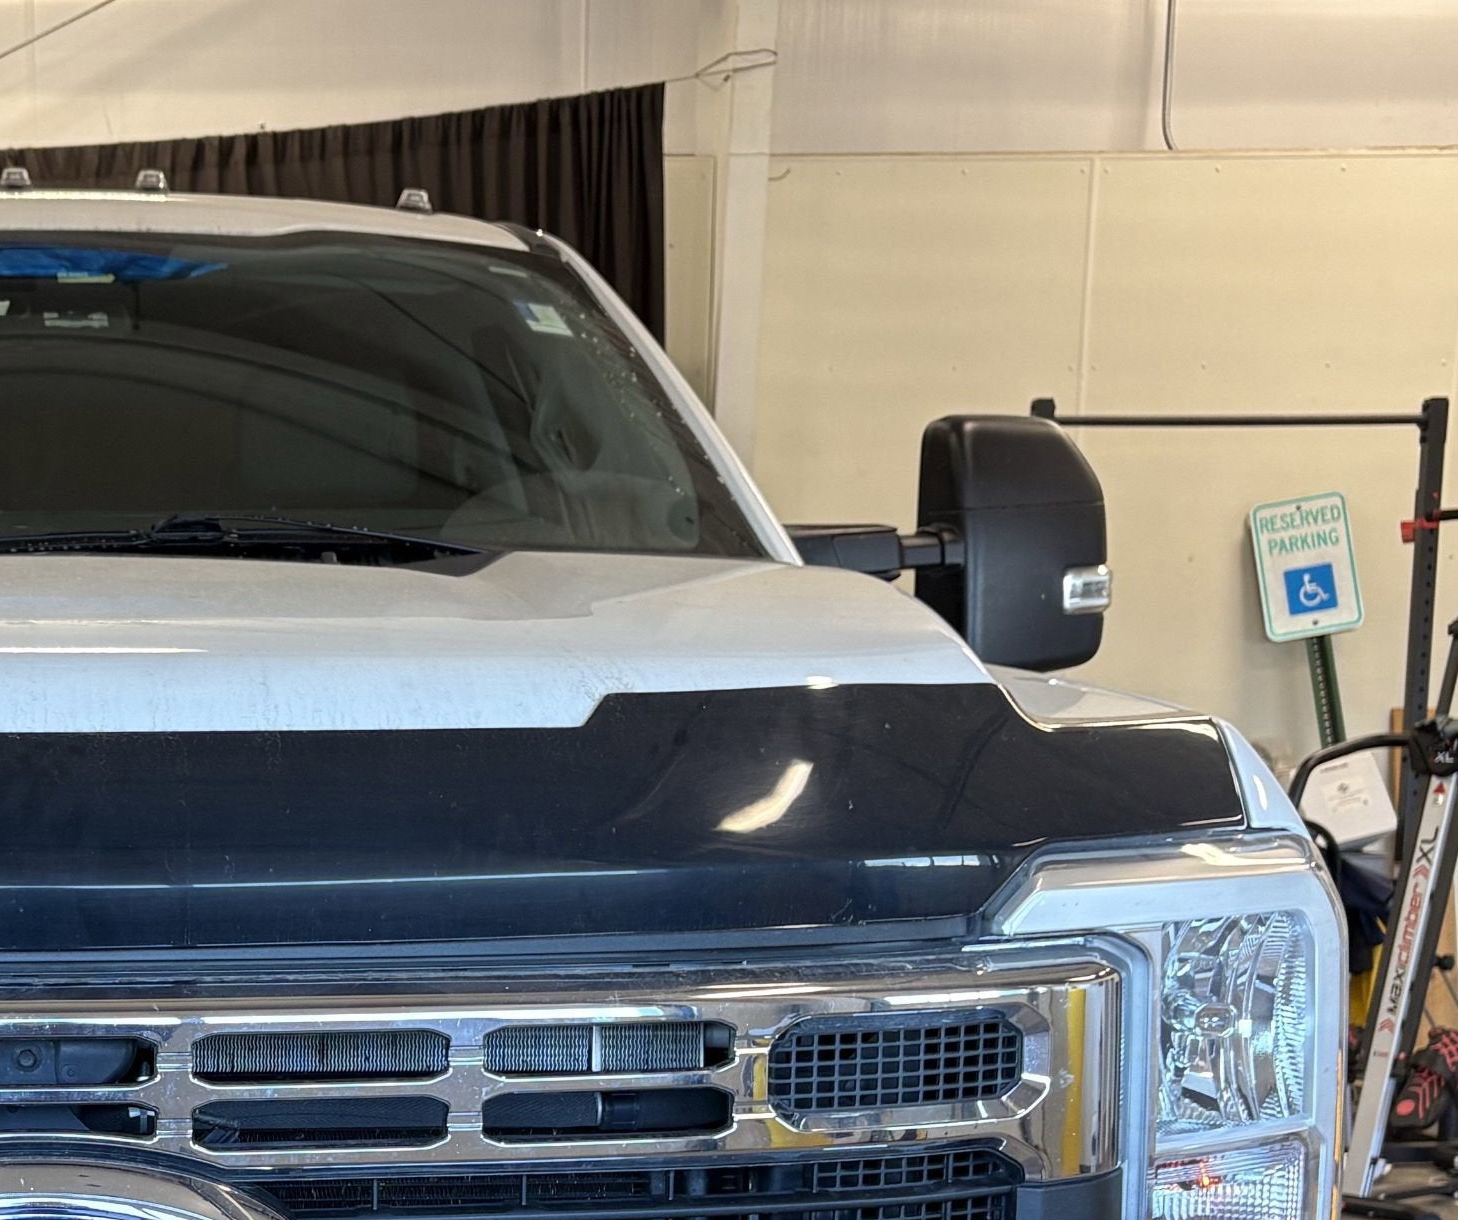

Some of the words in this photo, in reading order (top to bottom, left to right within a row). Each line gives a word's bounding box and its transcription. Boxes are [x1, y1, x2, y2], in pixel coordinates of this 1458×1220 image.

[1259, 504, 1342, 535] RESERVED
[1268, 528, 1340, 556] PARKING
[1434, 751, 1454, 764] XL
[1415, 825, 1439, 865] XL
